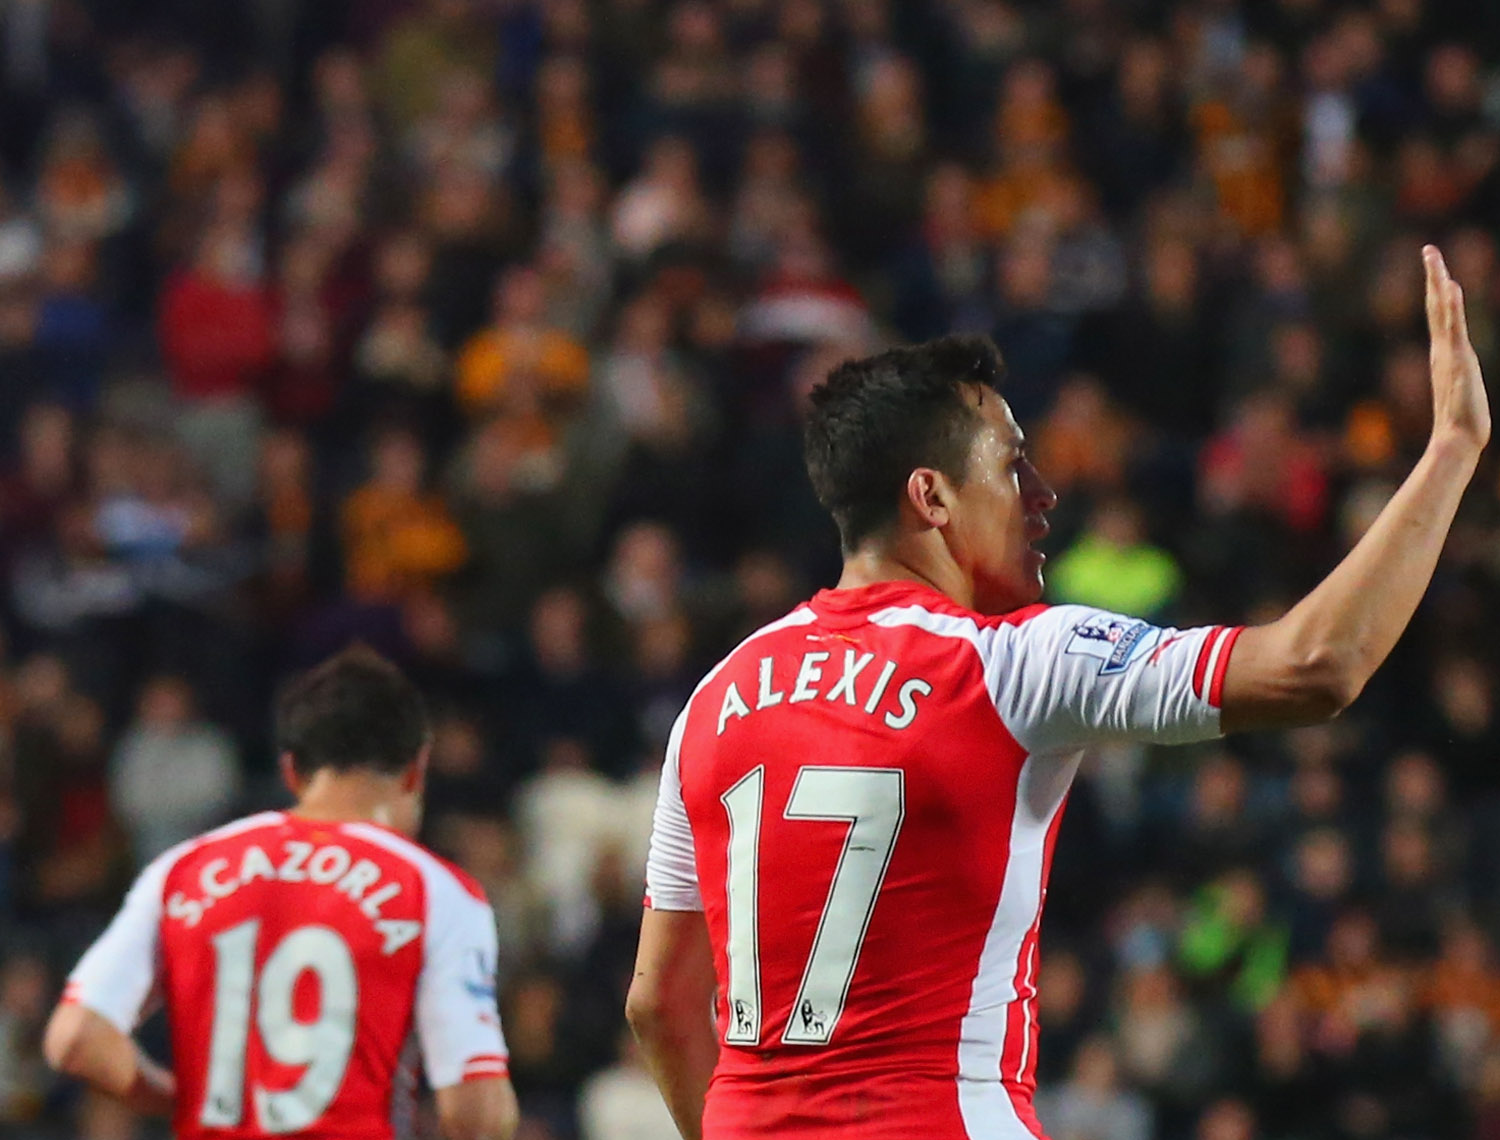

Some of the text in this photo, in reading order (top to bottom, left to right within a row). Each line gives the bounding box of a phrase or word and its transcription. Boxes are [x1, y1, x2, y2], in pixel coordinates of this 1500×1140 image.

[715, 648, 932, 736] ALEXIS
[167, 839, 421, 955] S.CAZORLA
[720, 764, 905, 1046] 17
[199, 919, 359, 1135] 19
